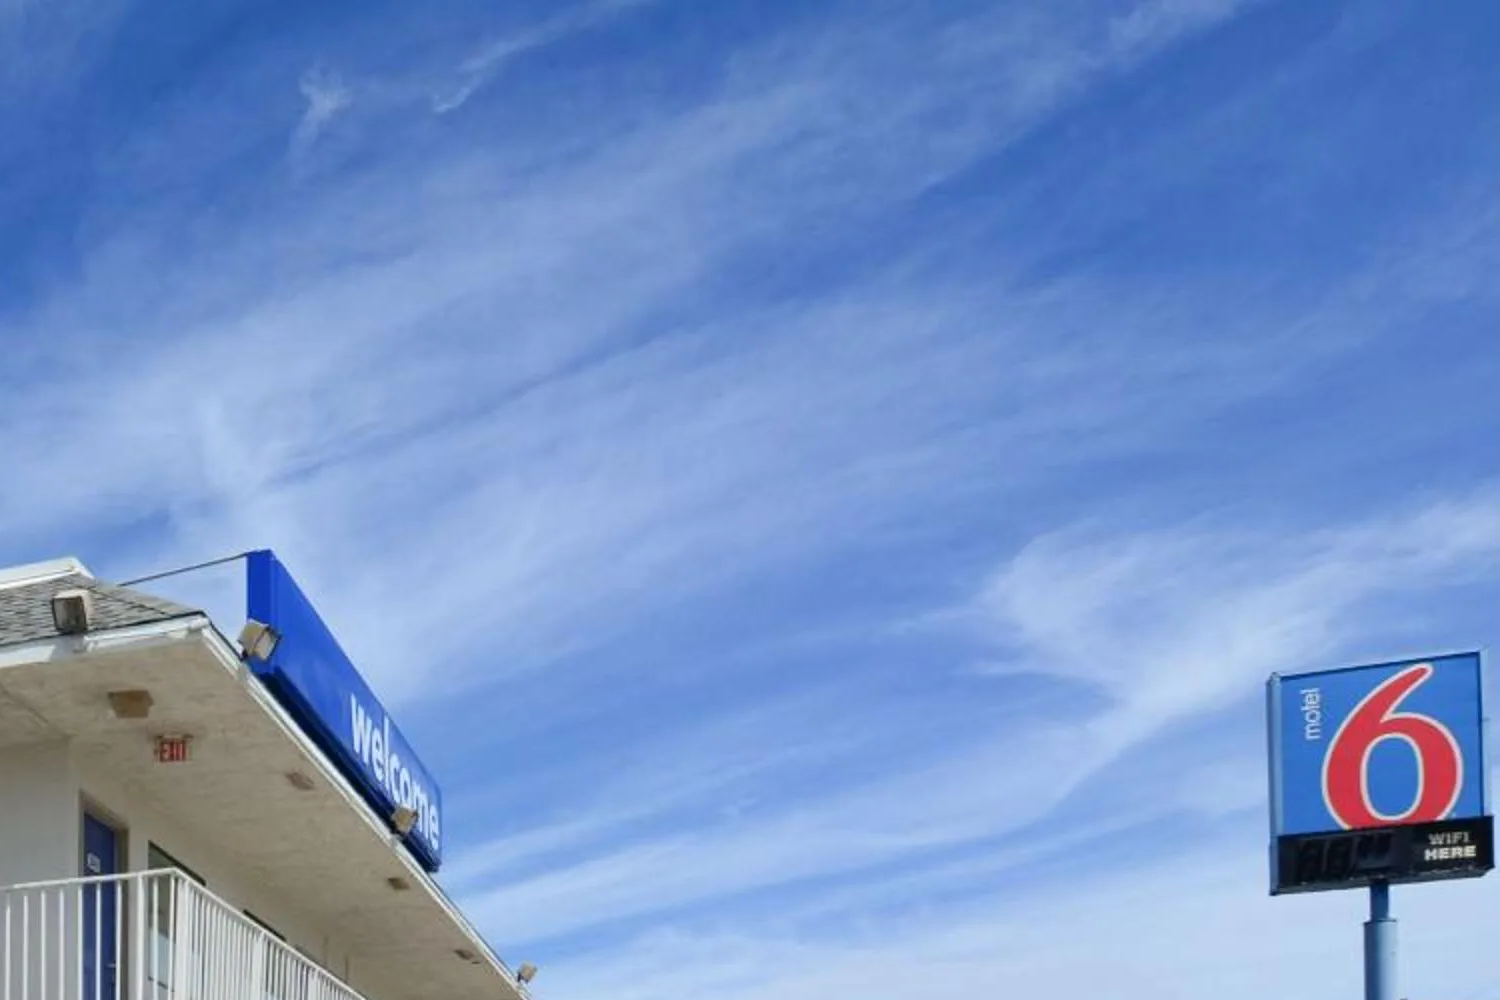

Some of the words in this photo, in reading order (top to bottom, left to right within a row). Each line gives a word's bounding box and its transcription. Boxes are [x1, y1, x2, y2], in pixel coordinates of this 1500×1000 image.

[1300, 687, 1321, 741] motel
[1321, 662, 1463, 830] 6
[1424, 845, 1476, 861] HERE
